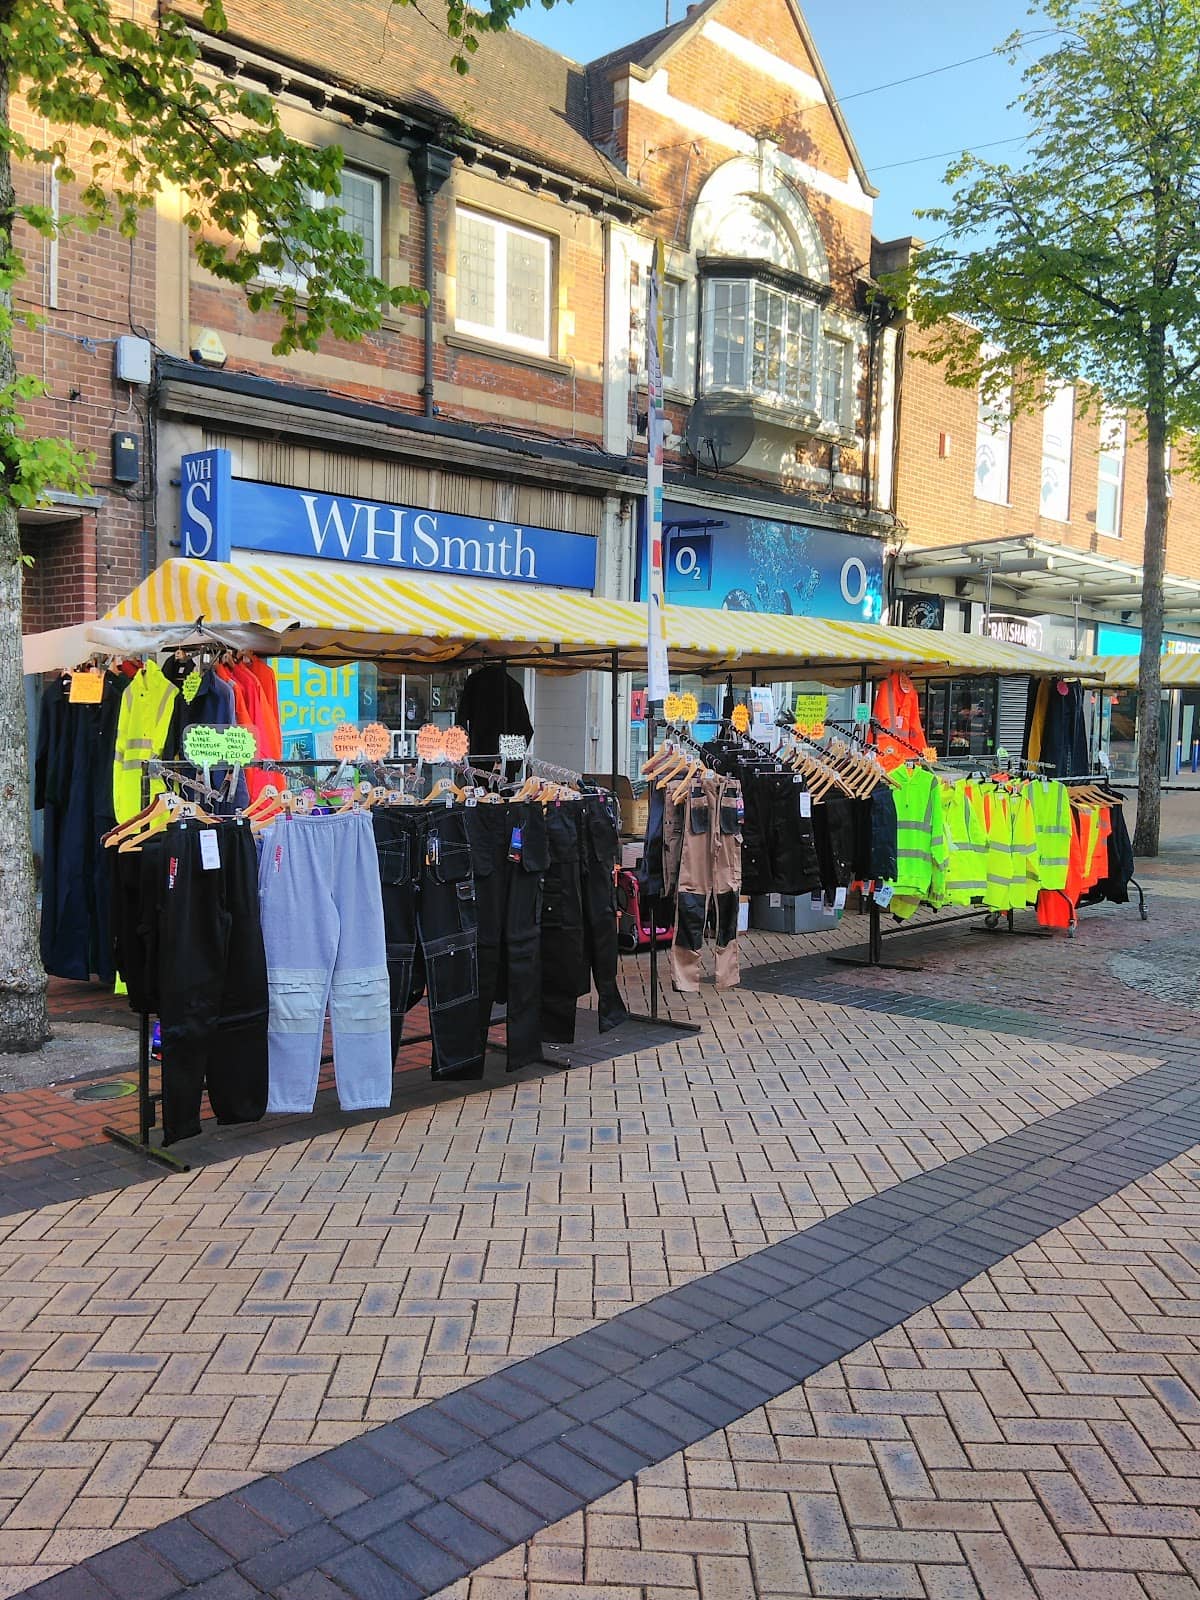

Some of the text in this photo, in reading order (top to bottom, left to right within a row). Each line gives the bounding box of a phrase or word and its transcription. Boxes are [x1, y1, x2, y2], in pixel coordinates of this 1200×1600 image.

[186, 458, 211, 482] WH
[185, 482, 213, 558] S
[300, 494, 539, 580] WHSmith
[675, 546, 701, 580] O2
[275, 658, 357, 697] Half
[281, 702, 346, 726] Price
